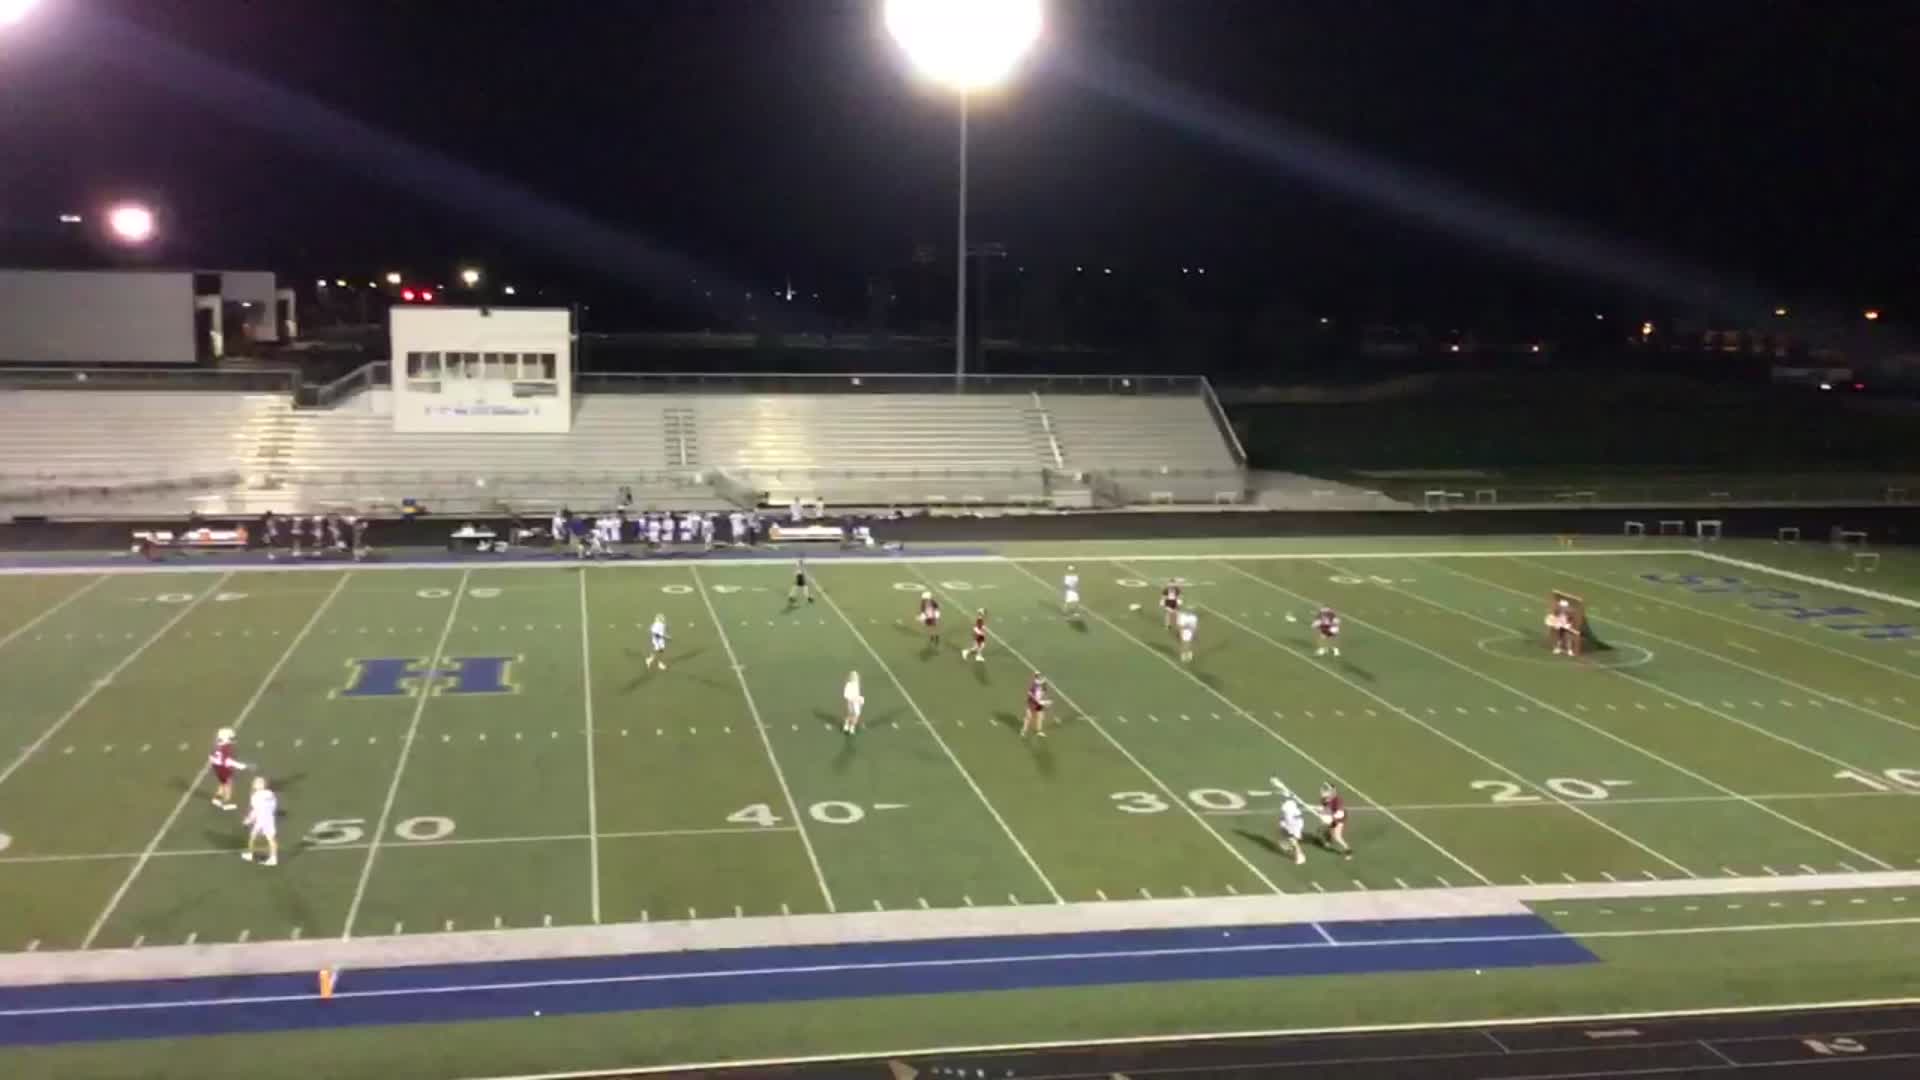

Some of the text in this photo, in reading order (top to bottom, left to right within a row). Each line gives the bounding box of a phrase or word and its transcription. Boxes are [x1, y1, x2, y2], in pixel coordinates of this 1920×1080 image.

[1108, 787, 1247, 814] 30
[1470, 777, 1609, 803] 20
[725, 800, 866, 827] 40
[302, 815, 457, 845] 50
